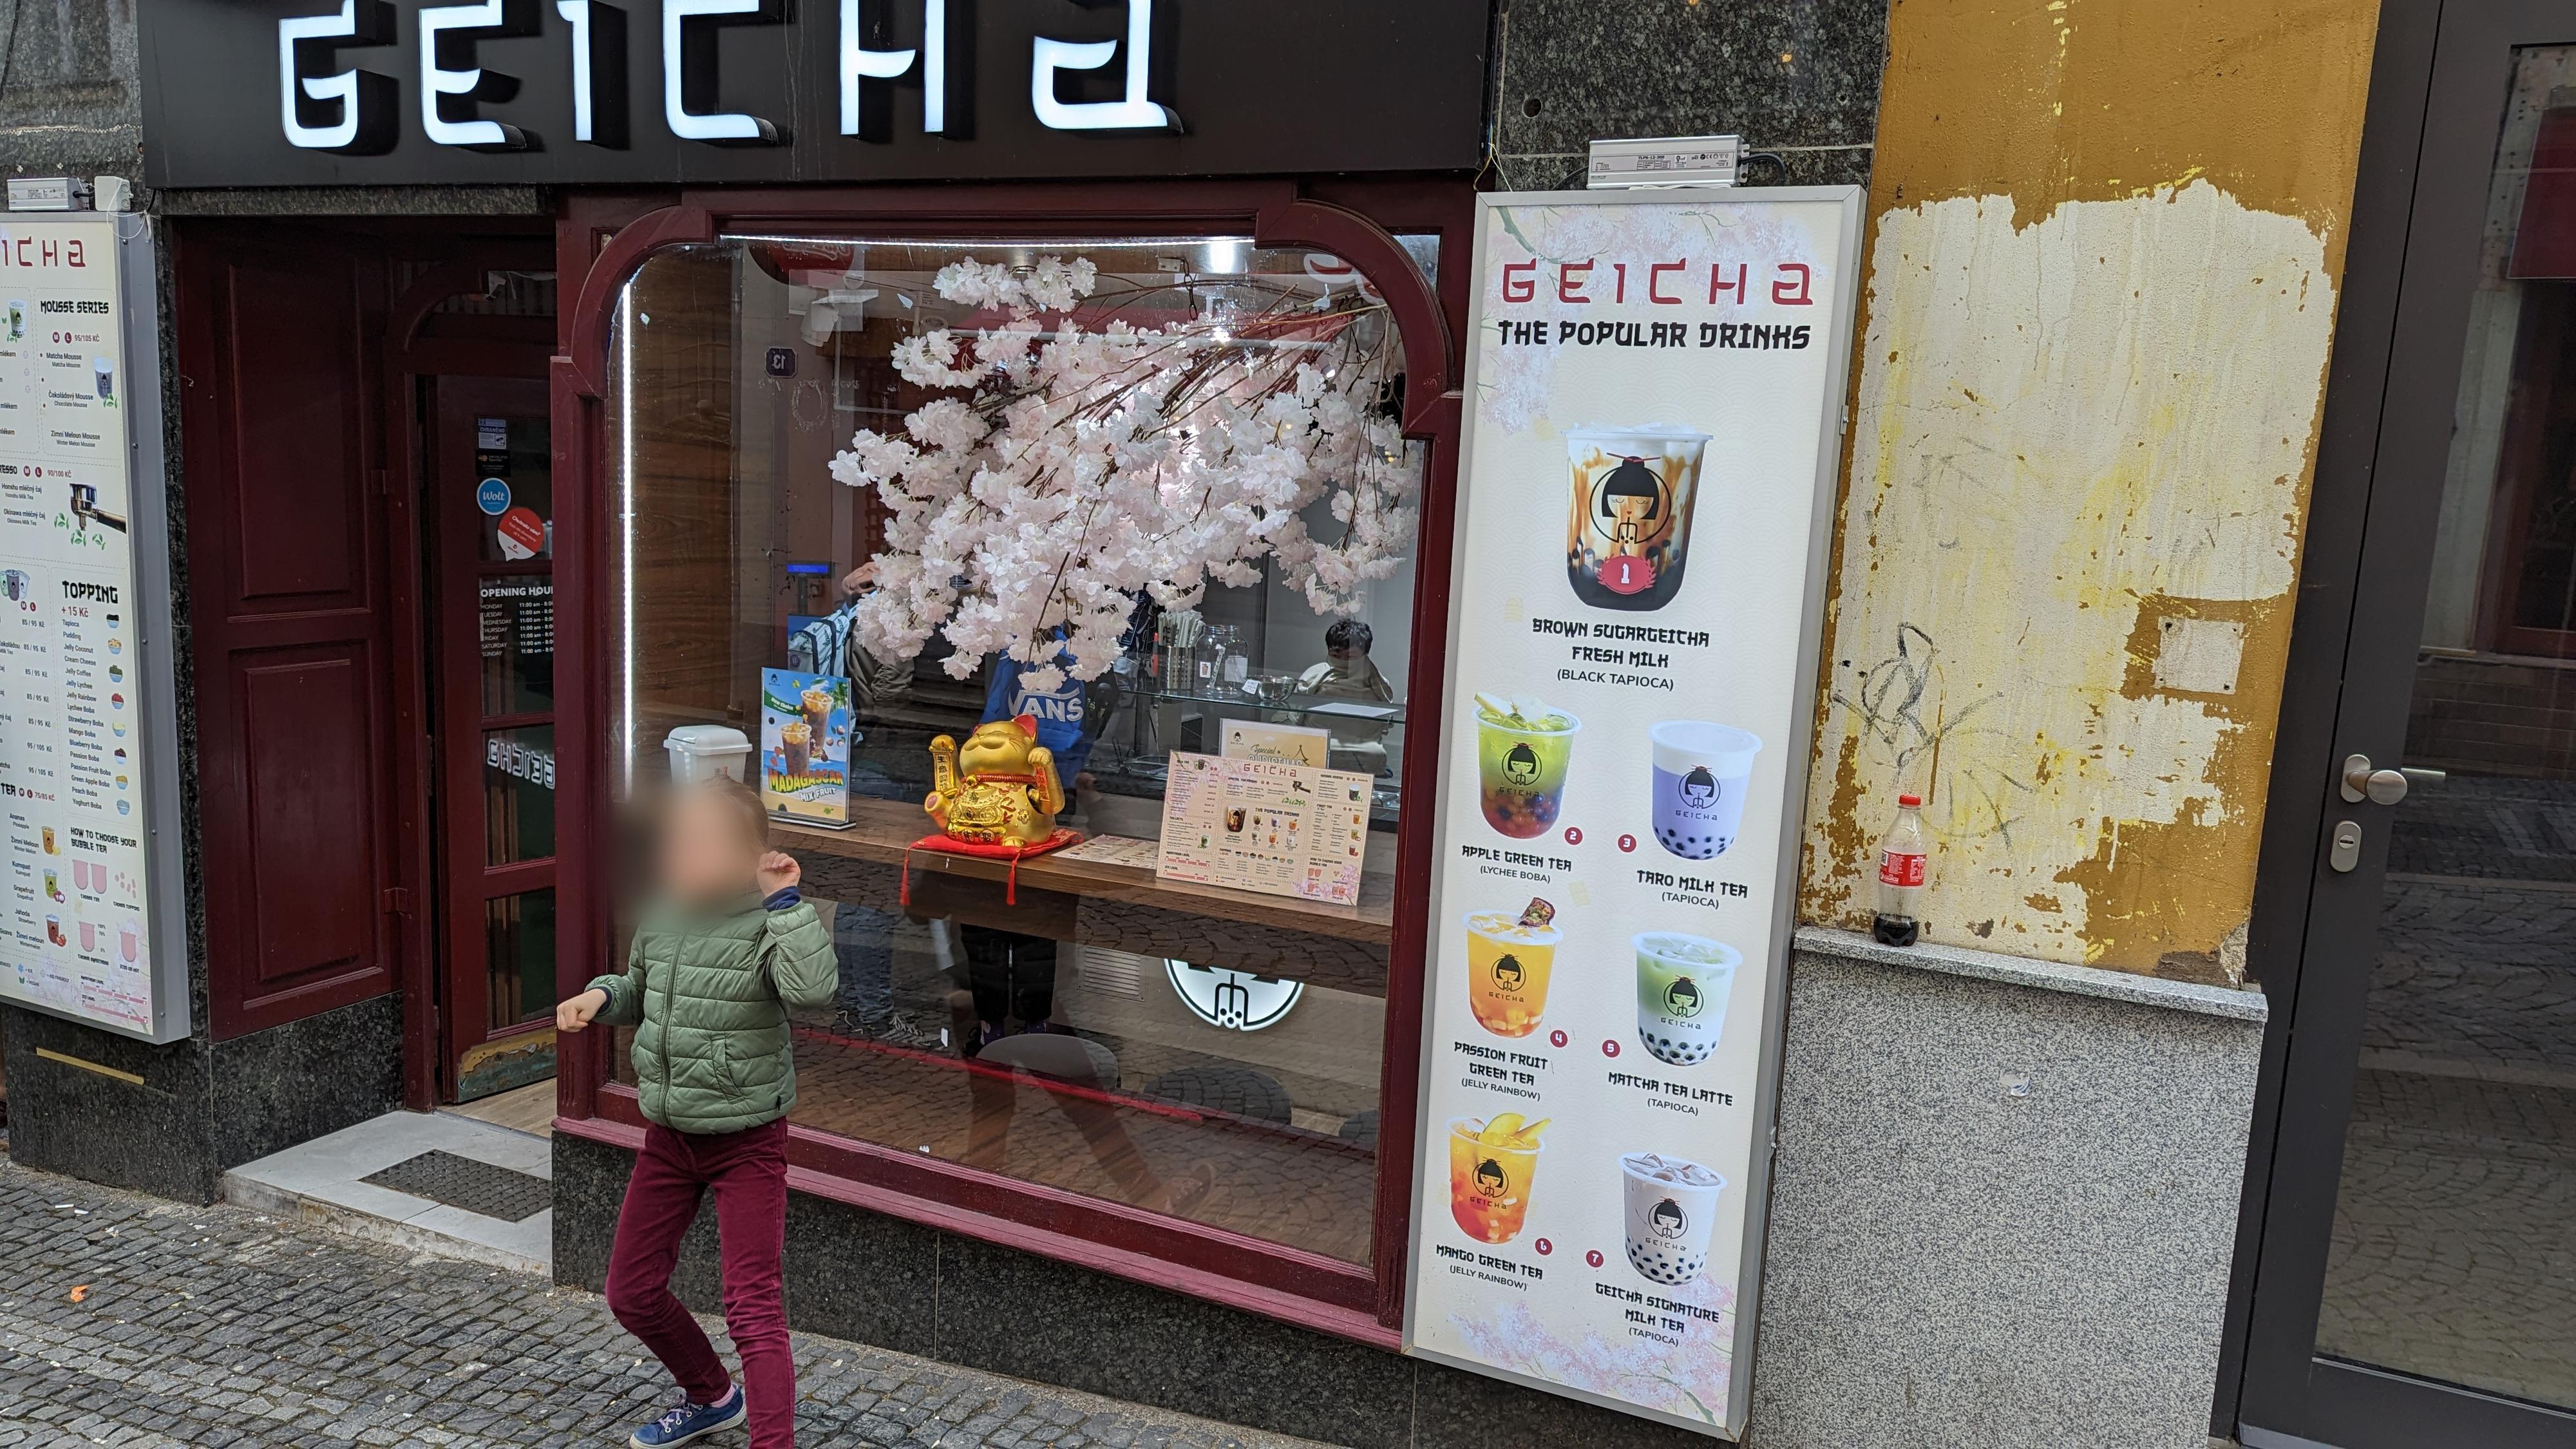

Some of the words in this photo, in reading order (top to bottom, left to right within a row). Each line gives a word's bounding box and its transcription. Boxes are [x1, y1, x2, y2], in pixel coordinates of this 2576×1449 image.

[41, 301, 74, 314] MOUSSE
[77, 301, 109, 314] SERIES
[1498, 320, 1547, 345] THE
[1558, 321, 1687, 348] POPULAR
[1700, 323, 1810, 349] DRINKS
[483, 491, 505, 500] Wolt
[1621, 564, 1629, 583] 1
[62, 580, 118, 604] TOPPING
[480, 587, 526, 597] OPENING
[529, 586, 553, 596] HOU
[68, 606, 77, 616] 15
[79, 607, 89, 618] Kč
[62, 619, 79, 627] Tapioca
[63, 632, 80, 641] Pudding
[1533, 618, 1588, 638] BROWN
[1593, 624, 1709, 648] SUGARGEICHA
[75, 645, 93, 654] Coconut
[1572, 646, 1624, 664] FRESH
[1629, 651, 1669, 668] MILK
[77, 681, 92, 689] Lychee
[1557, 668, 1605, 684] (BLACK
[1609, 674, 1674, 691] TAPIOCA)
[67, 692, 77, 700] Jelly
[78, 693, 97, 701] Rainbow
[1008, 687, 1084, 723] VANS
[69, 728, 84, 736] Mango
[70, 751, 87, 759] Passion
[88, 753, 99, 762] Boba
[1251, 744, 1276, 754] Special
[71, 763, 88, 772] Passion
[71, 775, 84, 783] Green
[768, 768, 845, 793] MADAGASCAR
[1, 783, 15, 796] TEA
[72, 787, 85, 795] Peach
[799, 791, 814, 802] MIX
[815, 786, 837, 798] FRUIT
[91, 802, 102, 810] Boba
[10, 813, 25, 821] Ananas
[71, 827, 84, 838] HOW
[86, 829, 93, 838] TO
[95, 831, 119, 844] CHOOSE
[120, 837, 137, 848] YOUR
[1569, 831, 1577, 840] 2
[1624, 838, 1631, 848] 3
[71, 838, 94, 851] BUBBLE
[96, 844, 107, 854] TEA
[1462, 845, 1500, 862] APPLE
[1504, 850, 1544, 869] GREEN
[1548, 857, 1571, 872] TEA
[1480, 866, 1517, 878] (LYCHEE
[1520, 870, 1551, 884] BOBA)
[1636, 869, 1674, 887] TARO
[1678, 876, 1715, 895] MILK
[1720, 882, 1748, 898] TEA
[1662, 892, 1719, 910] (TAPIOCA)
[1555, 1034, 1562, 1043] 4
[1454, 1042, 1505, 1062] PASSION
[1510, 1052, 1548, 1070] FRUIT
[1607, 1043, 1614, 1053] 5
[1469, 1063, 1508, 1082] GREEN
[1511, 1070, 1535, 1086] TEA
[1461, 1077, 1488, 1091] (JELLY
[1490, 1083, 1540, 1101] RAINBOW)
[1608, 1072, 1658, 1092] MATCHA
[1663, 1082, 1688, 1097] TEA
[1692, 1088, 1733, 1106] LATTE
[1647, 1097, 1699, 1116] (TAPIOCA)
[1436, 1244, 1474, 1262] MANGO
[1478, 1254, 1516, 1273] GREEN
[1520, 1264, 1543, 1280] TEA
[1591, 1254, 1598, 1263] 7
[1450, 1264, 1477, 1280] (JELLY
[1477, 1271, 1528, 1291] RAINBOW)
[1595, 1283, 1642, 1305] GEICHA
[1646, 1296, 1719, 1323] SIGNATURE
[1625, 1309, 1656, 1327] MILK
[1661, 1317, 1685, 1333] TEA
[1628, 1327, 1679, 1347] (TAPIOCA)
